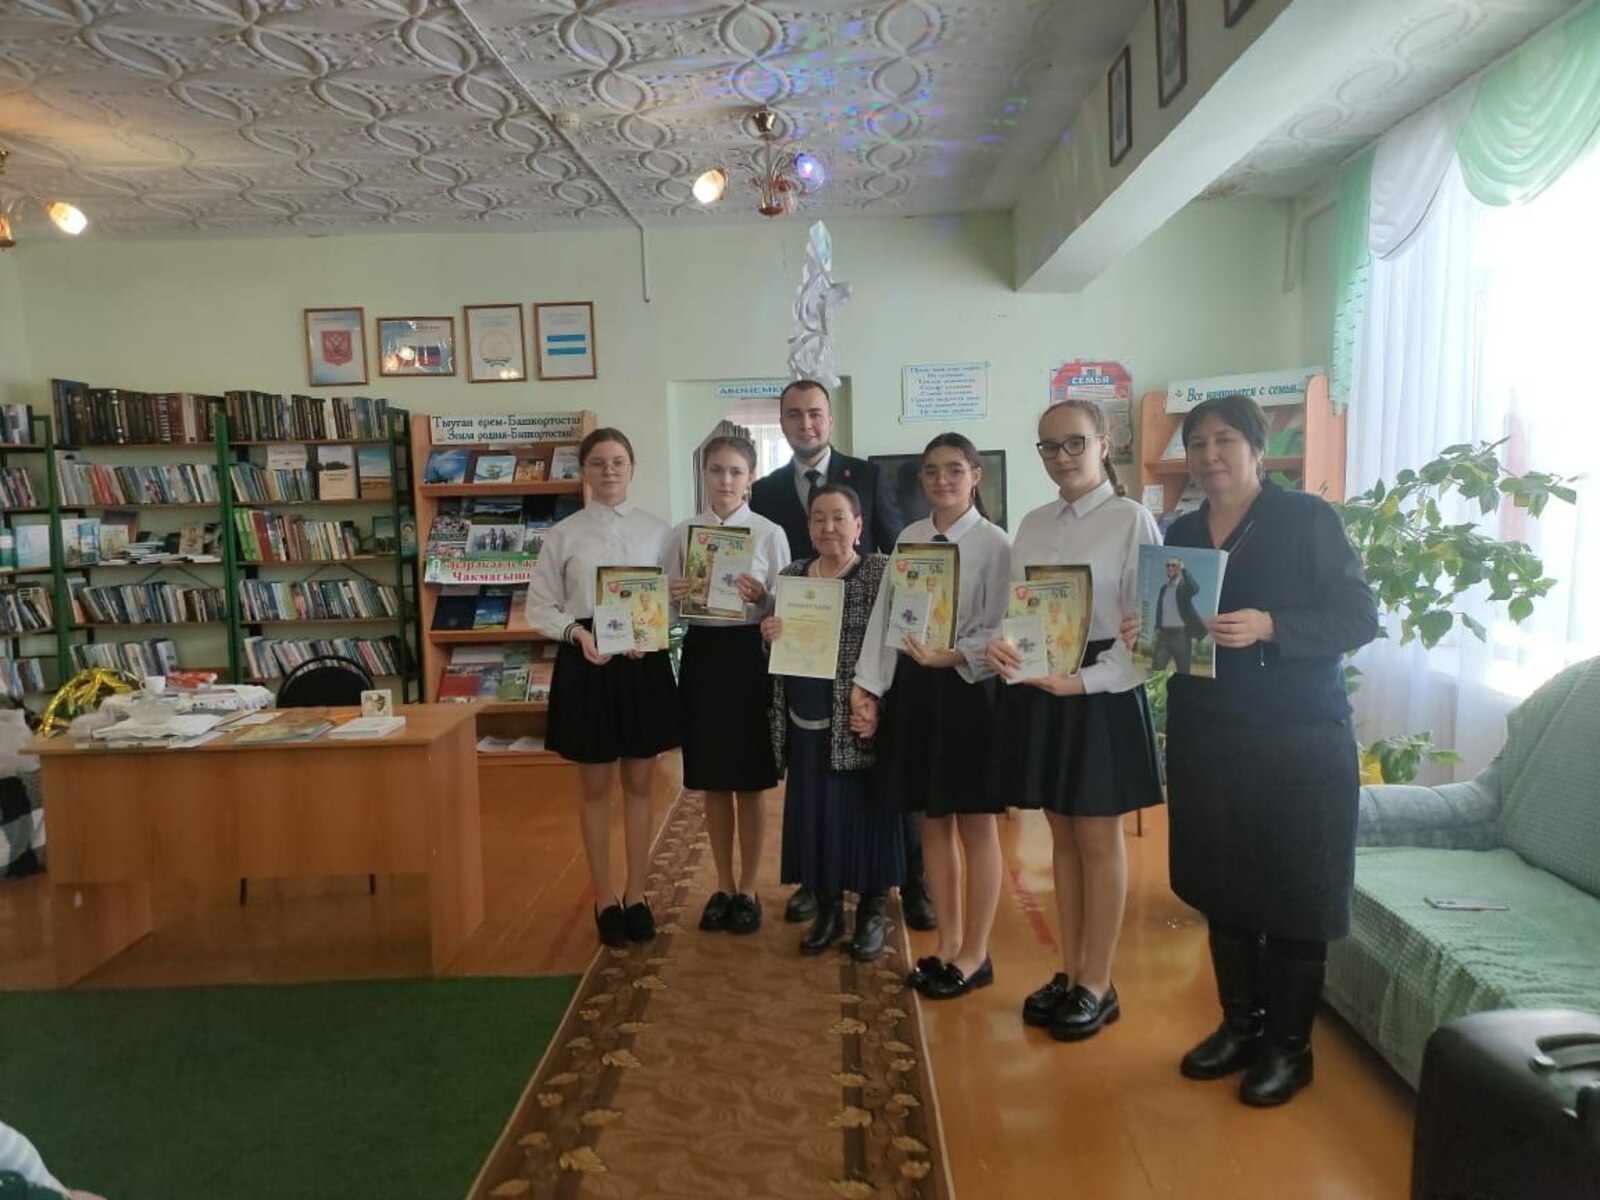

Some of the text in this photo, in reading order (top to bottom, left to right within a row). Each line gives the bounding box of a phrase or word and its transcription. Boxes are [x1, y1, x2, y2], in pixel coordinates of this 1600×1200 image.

[1071, 375, 1110, 385] СЕМЬЯ
[1186, 387, 1203, 402] Все
[1259, 386, 1265, 396] с
[447, 430, 475, 440] Земля
